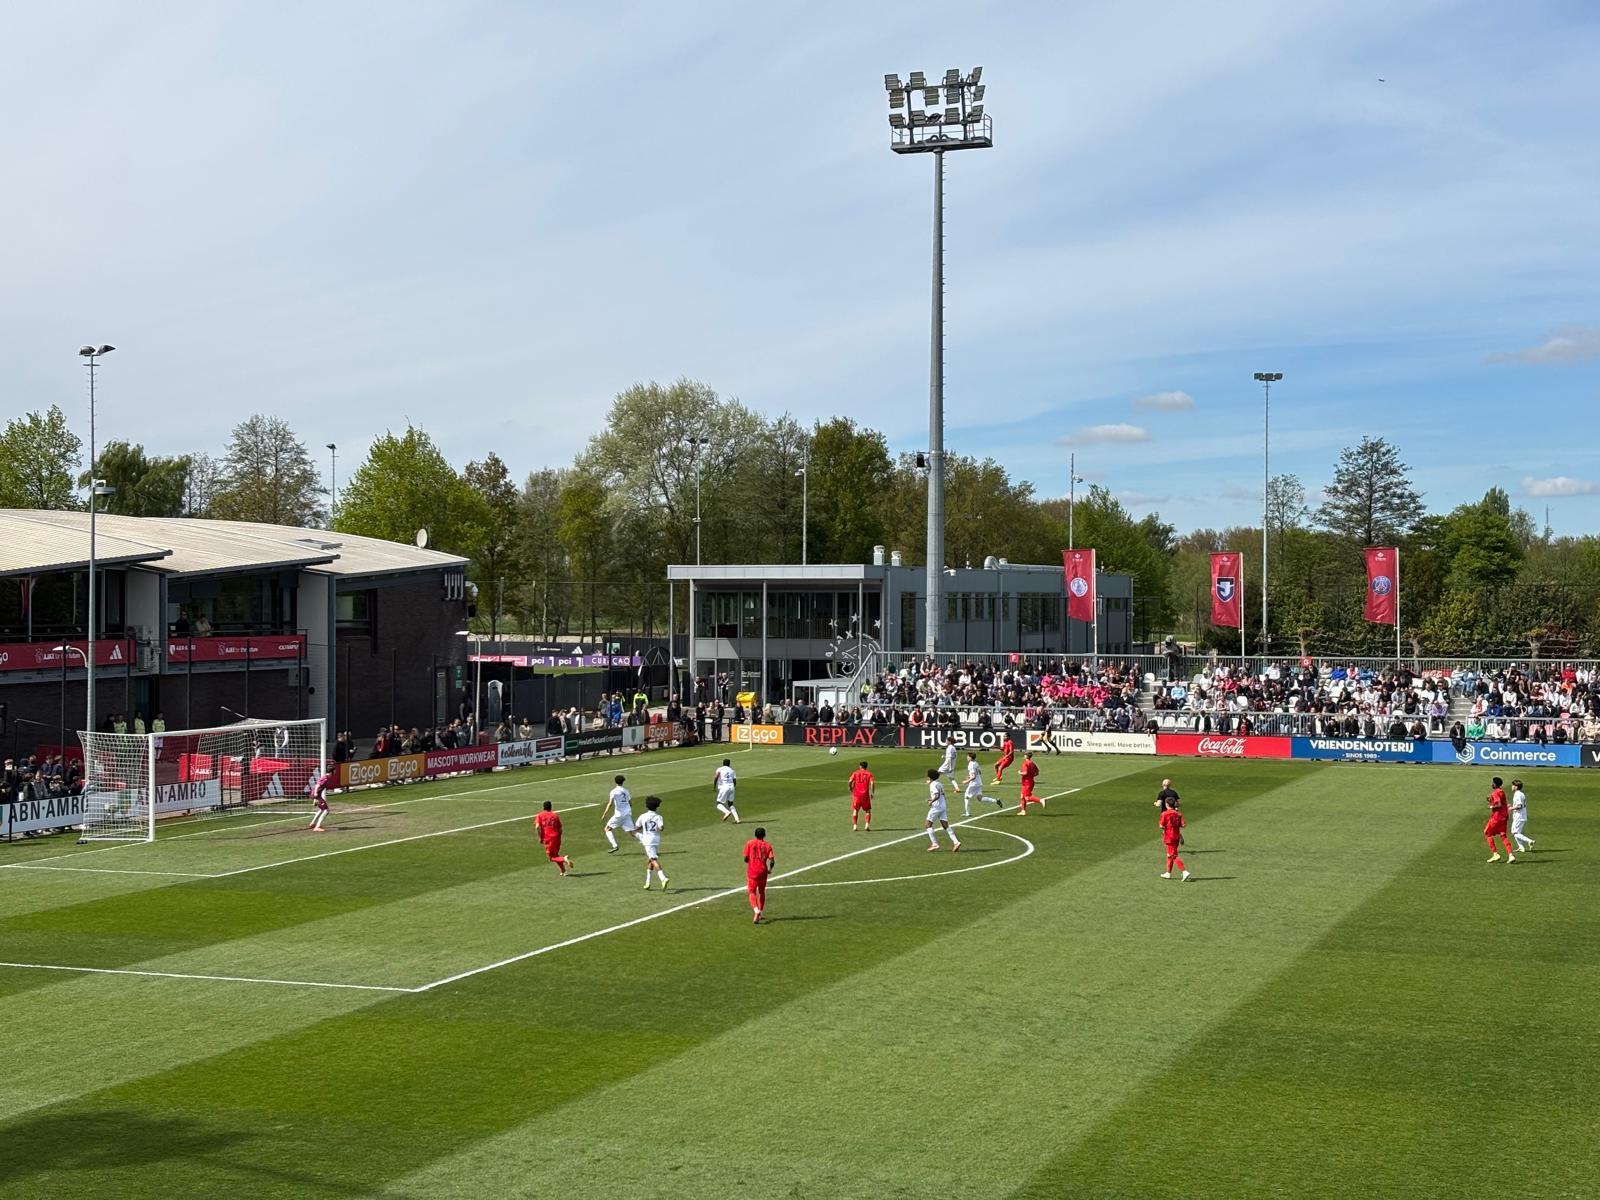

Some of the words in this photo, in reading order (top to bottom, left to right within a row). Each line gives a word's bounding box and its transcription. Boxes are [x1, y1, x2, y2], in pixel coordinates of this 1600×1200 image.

[805, 727, 877, 744] REPLAY
[921, 730, 1009, 748] HUBLOT
[1197, 737, 1247, 754] Coca-Cola
[1309, 739, 1414, 753] VRIENDENLOTERIJ
[459, 750, 496, 765] WORKWEAR
[1480, 746, 1556, 762] Coinmerce
[644, 820, 658, 832] 12
